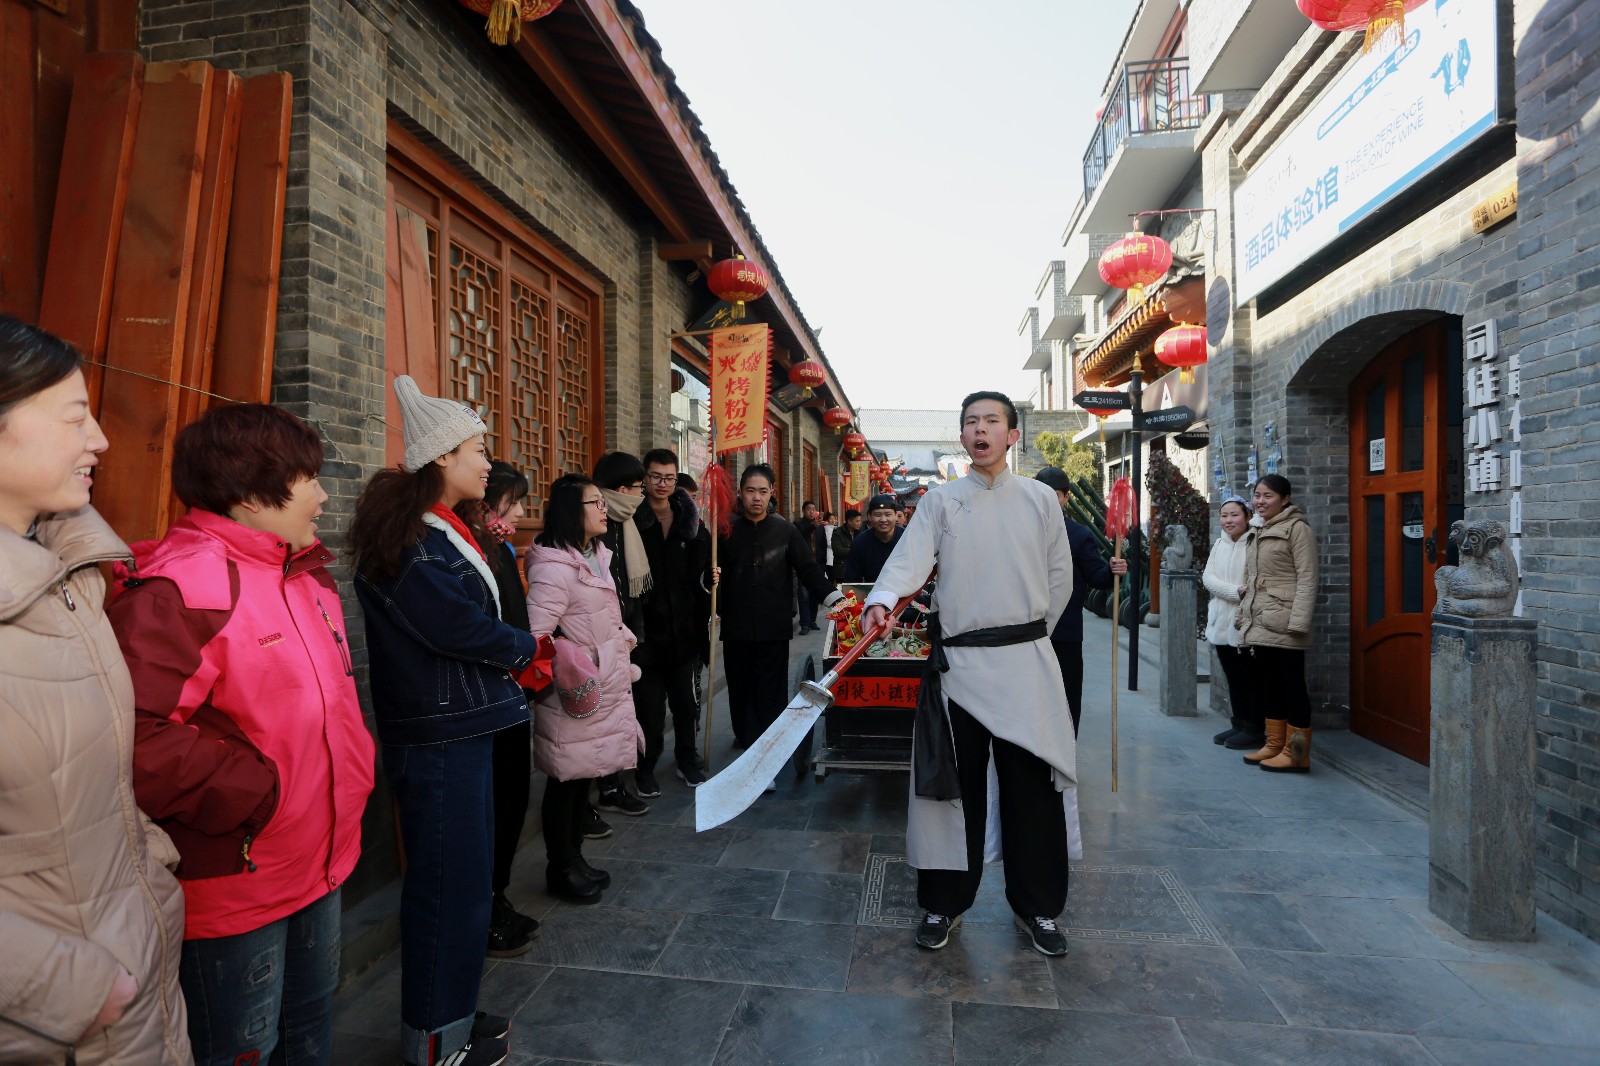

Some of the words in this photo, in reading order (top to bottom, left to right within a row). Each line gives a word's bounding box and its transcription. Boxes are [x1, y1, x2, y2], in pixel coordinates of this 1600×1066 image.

[1345, 150, 1362, 172] THE
[1363, 95, 1424, 157] EXPERIENCE
[1385, 135, 1397, 154] OF
[1399, 113, 1424, 143] WINE
[1245, 165, 1339, 273] 酒品体验馆
[1493, 191, 1517, 214] 024
[1465, 318, 1502, 493] 司徒小镇
